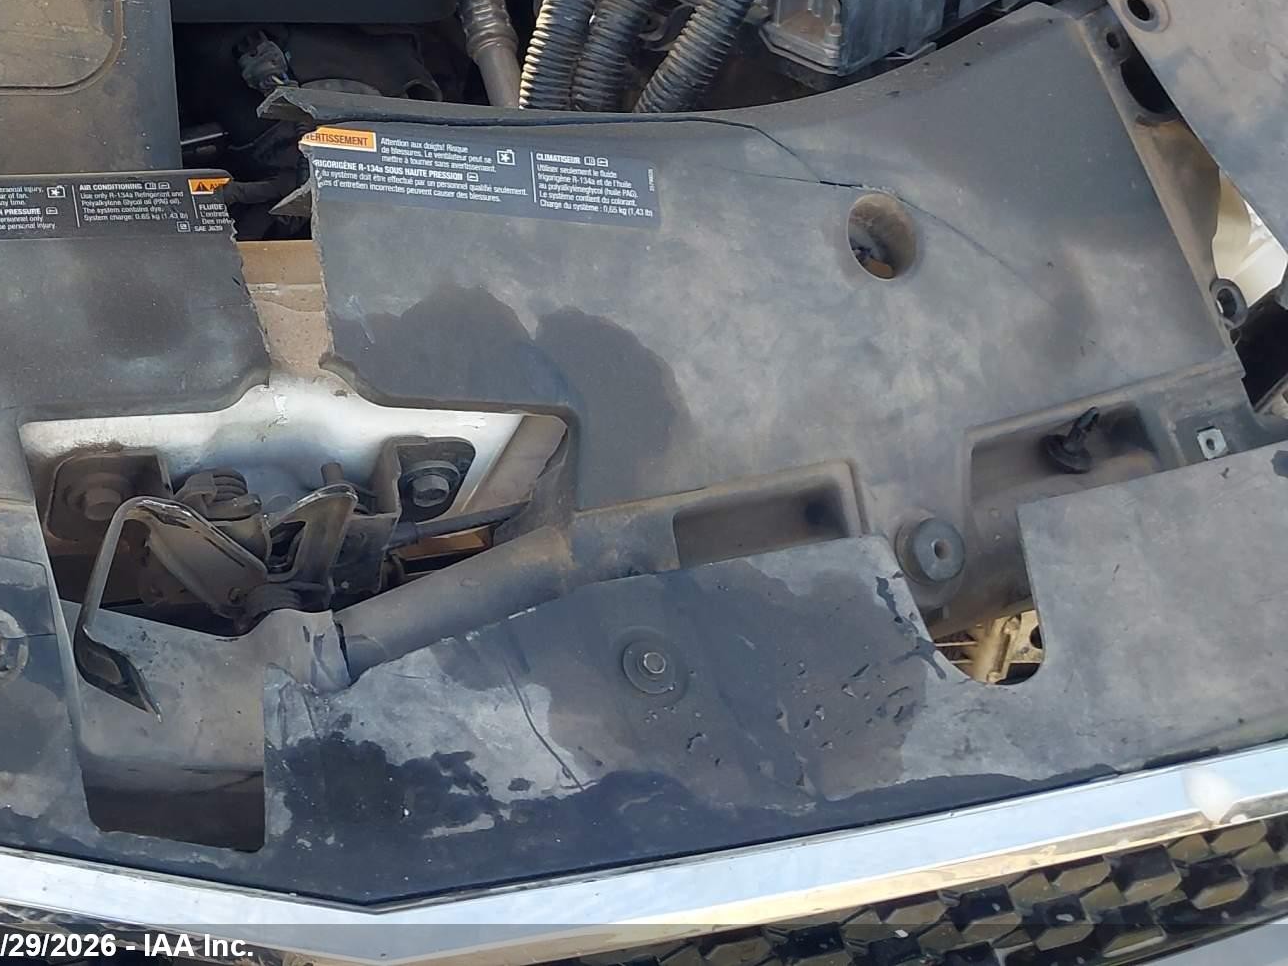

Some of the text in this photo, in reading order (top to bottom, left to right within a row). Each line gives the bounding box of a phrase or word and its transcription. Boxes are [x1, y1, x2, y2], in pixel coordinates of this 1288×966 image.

[381, 138, 409, 147] Attention
[446, 144, 468, 153] Risque
[410, 157, 433, 166] tourner
[424, 150, 432, 158] Le
[433, 152, 467, 161] ventilateur
[468, 155, 482, 163] peut
[536, 153, 581, 164] CLIMATISEUR
[358, 165, 383, 173] R-134a
[384, 166, 403, 175] SOUS
[404, 167, 428, 177] HAUTE
[428, 169, 463, 181] PRESSION
[537, 164, 617, 178] Utiliser seulement le fluide
[331, 170, 358, 180] système
[358, 173, 372, 181] doit
[372, 174, 386, 182] être
[387, 176, 414, 185] effectué
[436, 181, 468, 190] personnel
[537, 172, 571, 183] frigorigène
[572, 175, 595, 185] R-134a
[92, 183, 143, 191] CONDITIONING
[369, 183, 405, 193] incorrectes
[406, 187, 432, 196] peuvent
[433, 189, 455, 198] causer
[456, 191, 468, 199] des
[94, 192, 108, 200] only
[122, 198, 143, 206] Glycol
[539, 190, 548, 198] Le
[548, 192, 574, 200] système
[575, 194, 601, 203] contient
[601, 196, 610, 204] du
[4, 207, 41, 215] PRESSURE
[540, 199, 562, 209] Charge
[563, 202, 572, 210] du
[572, 203, 599, 212] système
[618, 206, 627, 215] kg
[83, 214, 109, 222] System
[7, 222, 35, 231] personal
